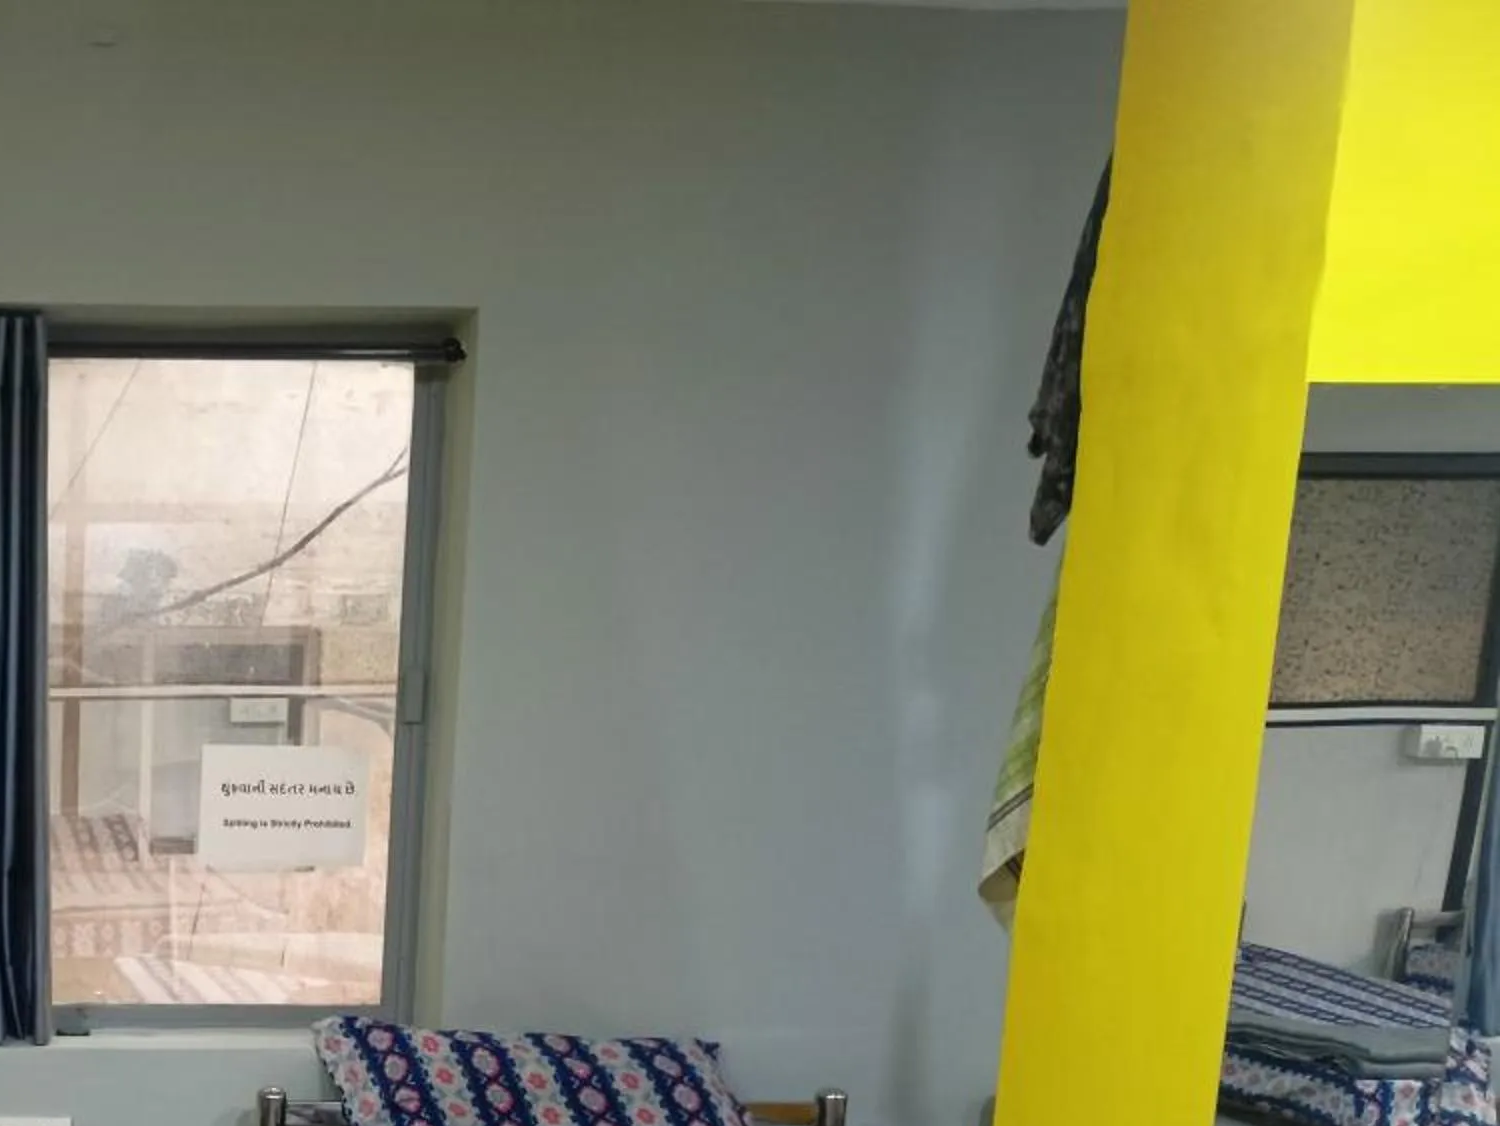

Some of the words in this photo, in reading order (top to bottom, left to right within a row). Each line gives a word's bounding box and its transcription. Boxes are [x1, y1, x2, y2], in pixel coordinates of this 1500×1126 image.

[223, 818, 258, 830] Spitting
[259, 818, 268, 828] is
[270, 818, 301, 830] Strictly
[303, 818, 351, 829] Prohibited
